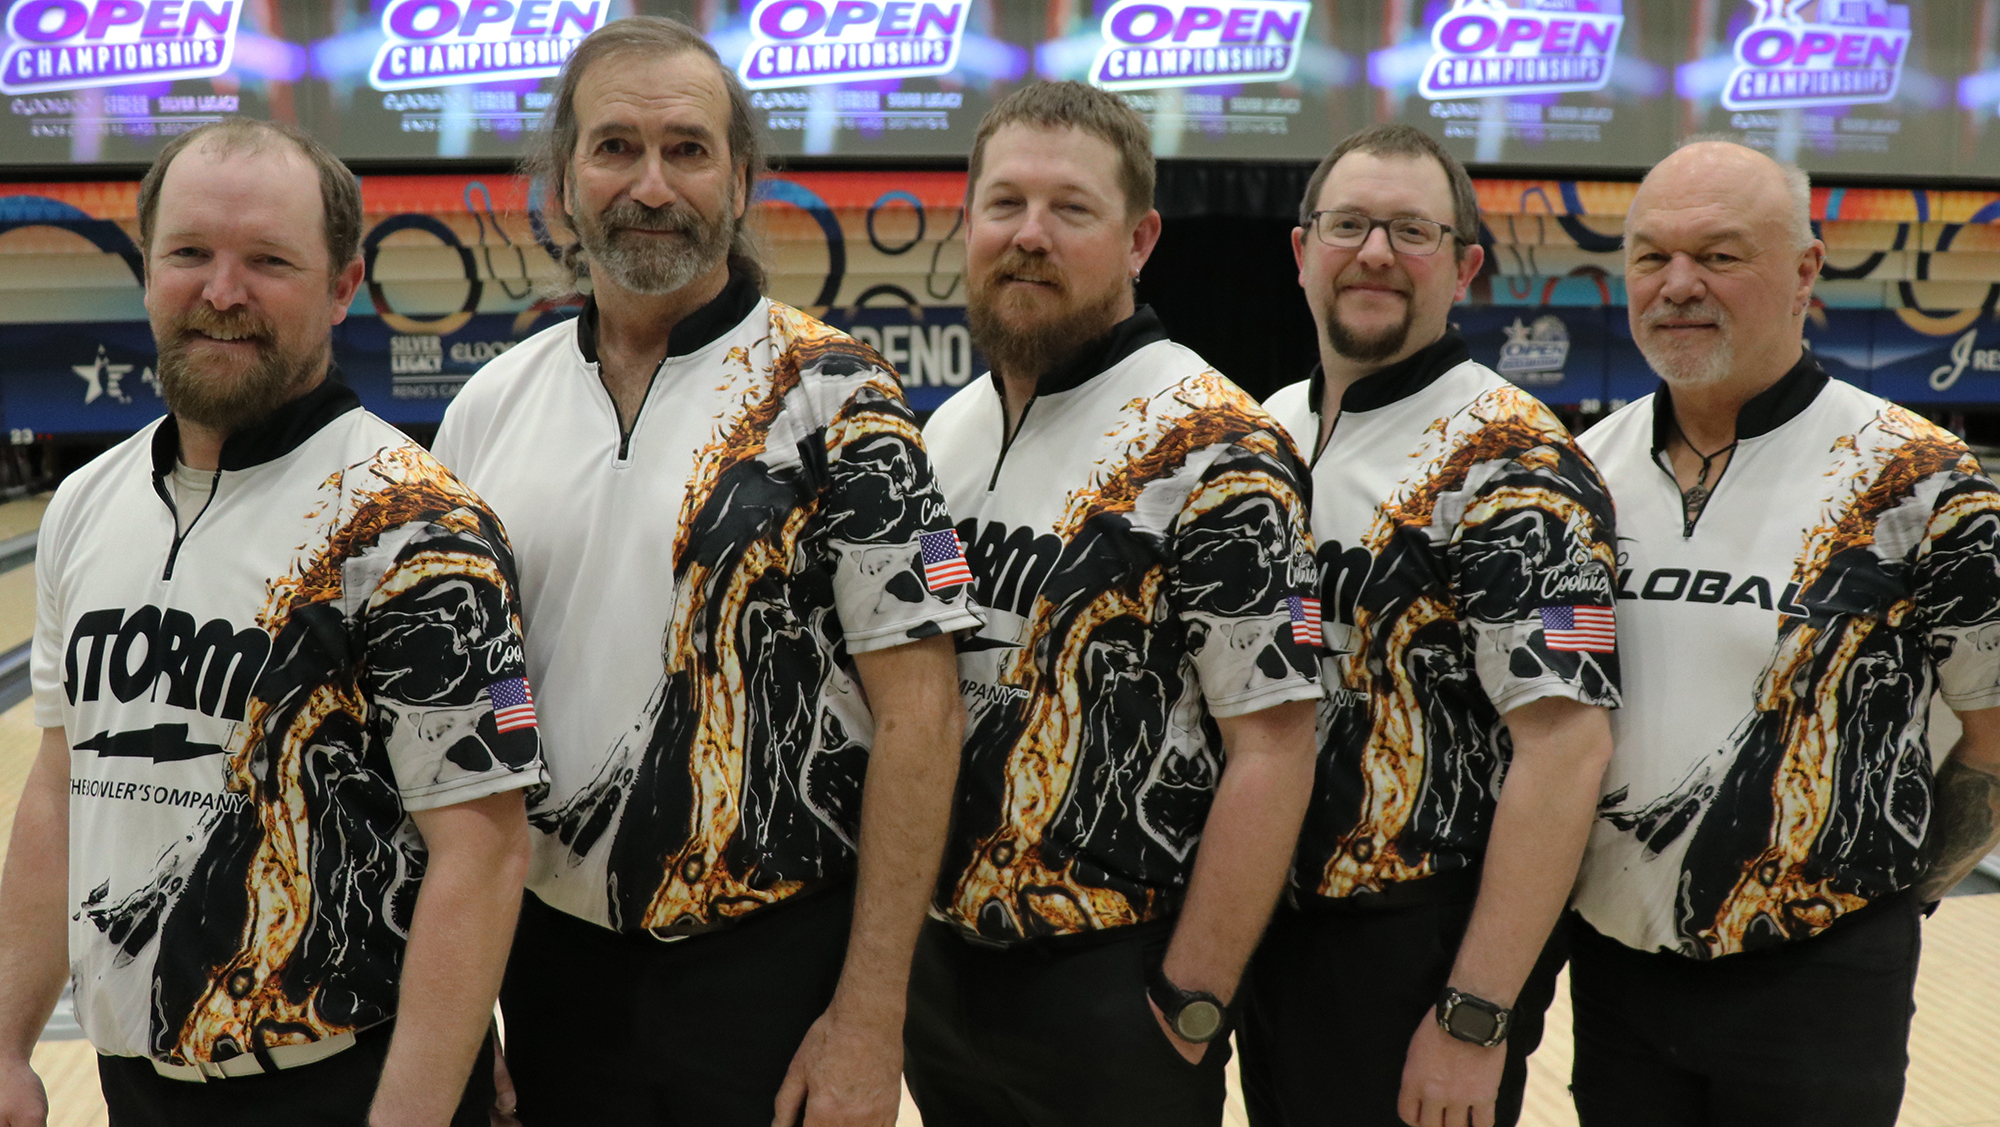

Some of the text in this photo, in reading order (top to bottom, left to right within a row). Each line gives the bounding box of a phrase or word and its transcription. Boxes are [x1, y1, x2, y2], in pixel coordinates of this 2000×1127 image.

[13, 0, 234, 43] OPEN
[390, 0, 600, 40] OPEN
[759, 0, 962, 40] OPEN
[1111, 4, 1302, 44] OPEN
[1440, 15, 1615, 54] OPEN
[17, 39, 218, 79] CHAMPIONSHIPS
[758, 40, 945, 75] CHAMPIONSHIPS
[1108, 48, 1285, 78] CHAMPIONSHIPS
[1742, 29, 1903, 67] OPEN
[1437, 57, 1599, 86] CHAMPIONSHIPS
[1738, 71, 1888, 98] CHAMPIONSHIPS
[921, 498, 951, 526] Coo
[1616, 567, 1810, 618] LOBAL
[63, 604, 272, 722] STORM
[151, 785, 249, 813] OMPANY
